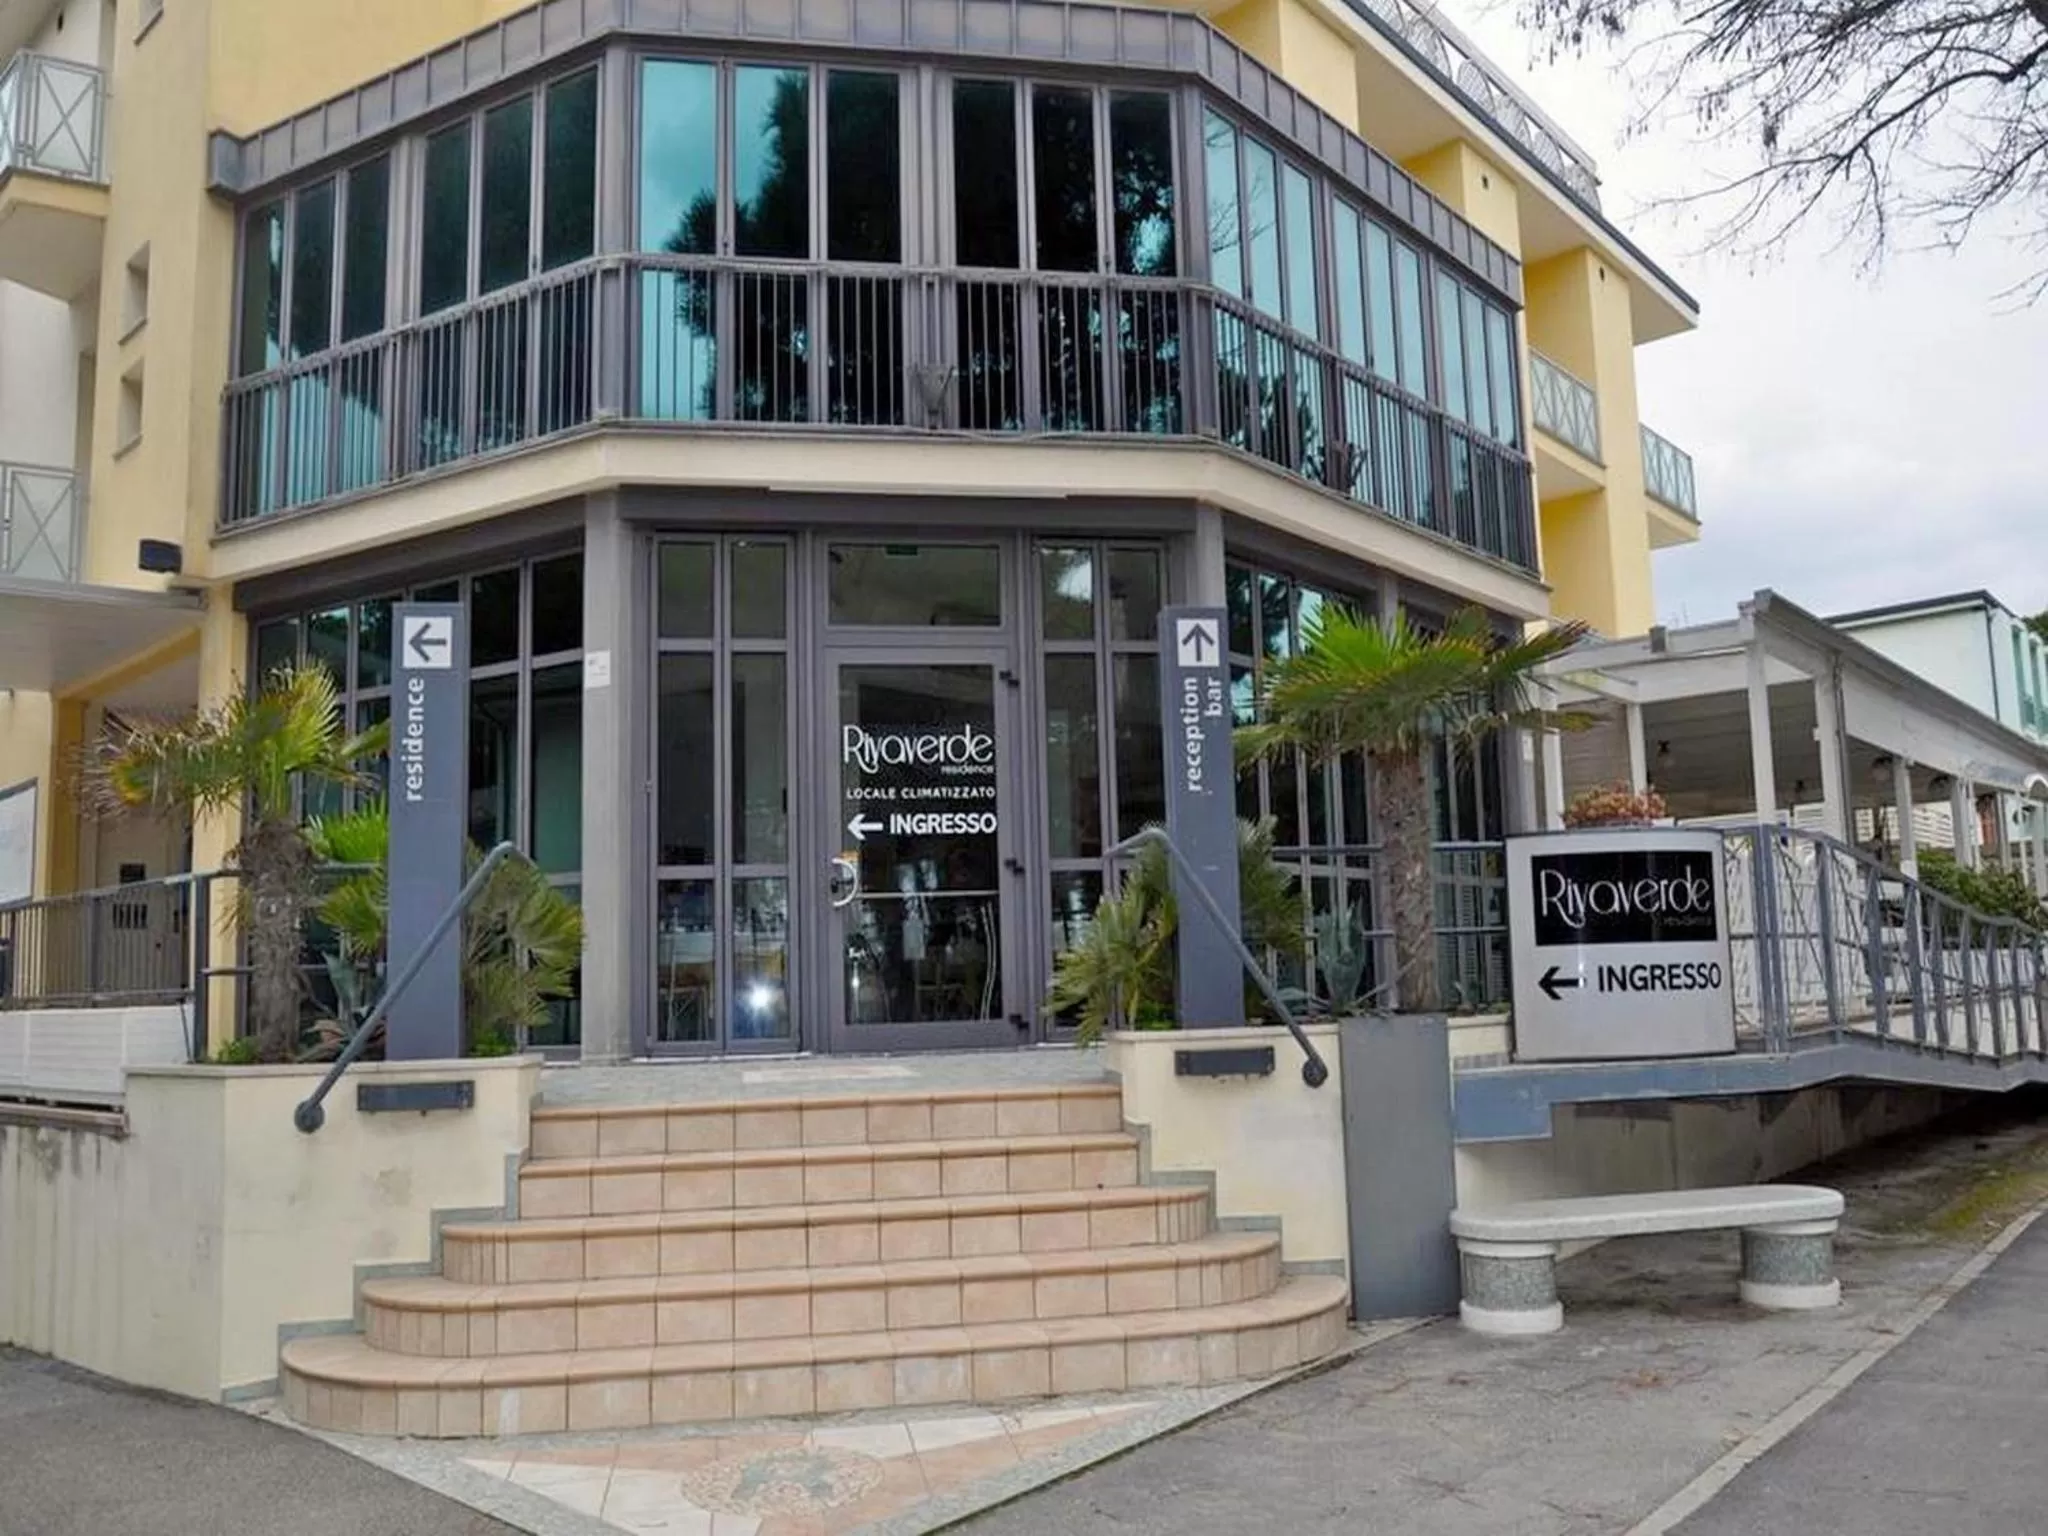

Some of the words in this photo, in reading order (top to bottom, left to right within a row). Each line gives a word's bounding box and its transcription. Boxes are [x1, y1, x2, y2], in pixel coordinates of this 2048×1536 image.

[1204, 676, 1223, 717] bar
[401, 677, 424, 801] residence
[843, 724, 993, 774] Rivaverde
[1180, 676, 1205, 792] reception
[847, 787, 896, 800] LOCALE
[901, 787, 996, 800] CLIMATIZZATO
[890, 813, 997, 834] INGRESSO
[1540, 865, 1710, 928] Rivaverde
[1598, 962, 1721, 992] INGRESSO
